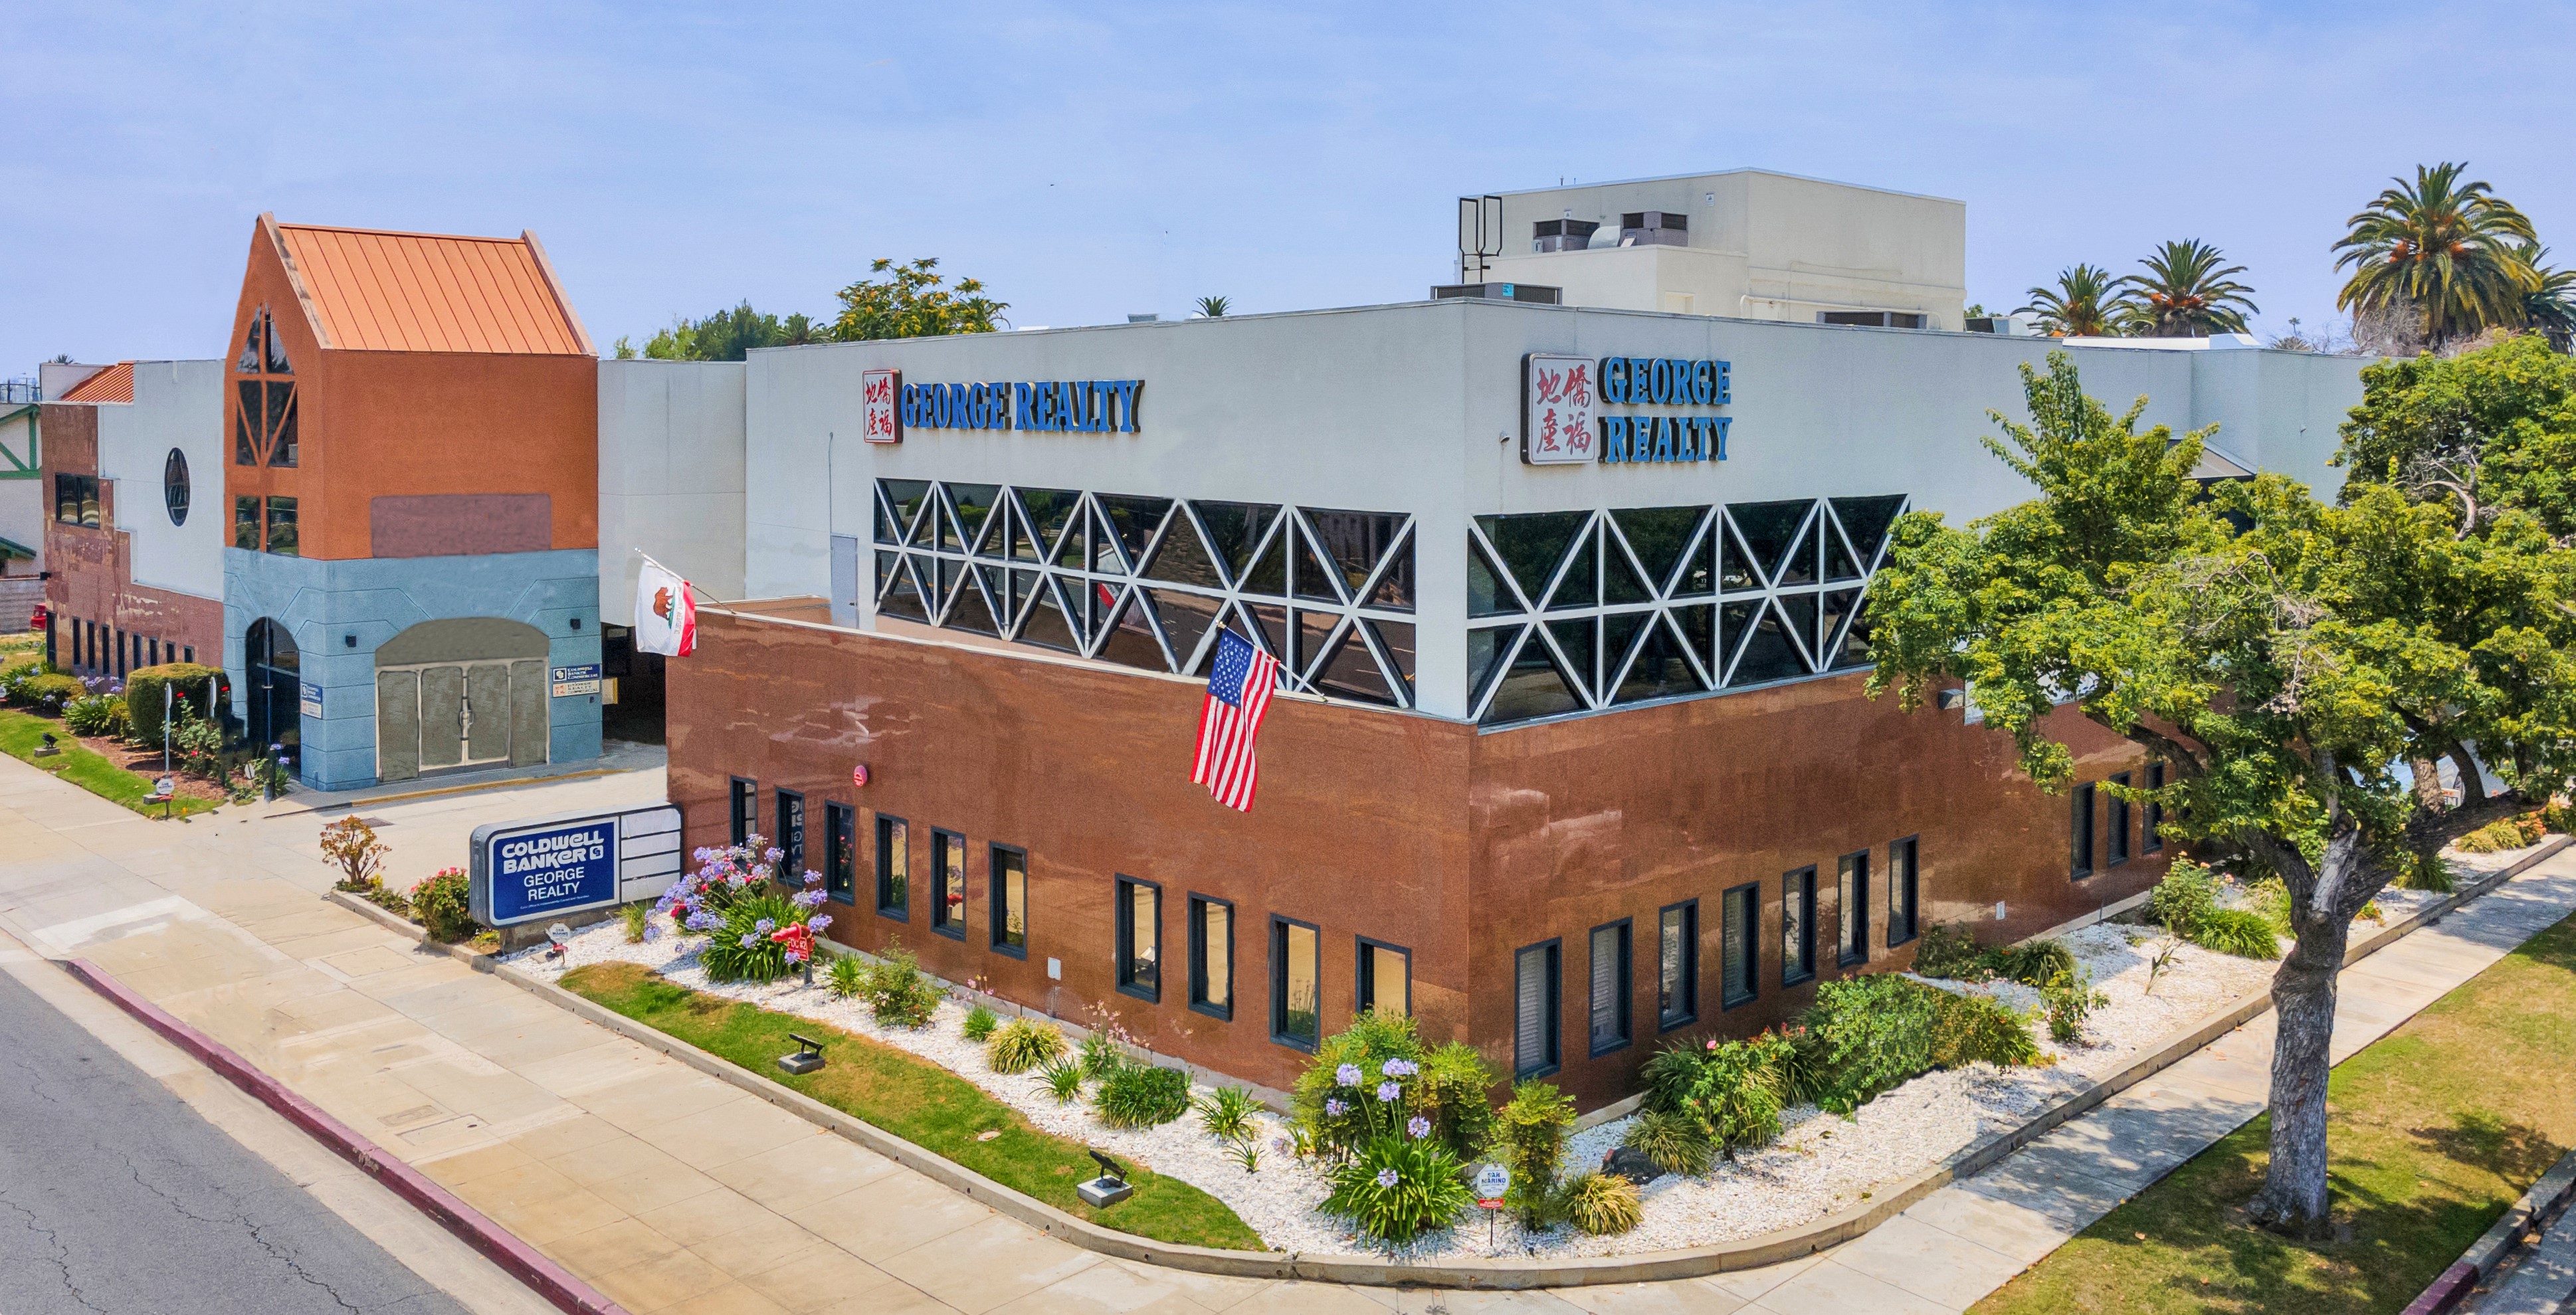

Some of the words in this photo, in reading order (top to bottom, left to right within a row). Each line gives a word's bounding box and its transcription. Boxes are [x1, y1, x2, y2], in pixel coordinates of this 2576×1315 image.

[1602, 355, 1732, 405] GEORGE
[901, 381, 1009, 430] GEORGE
[1014, 380, 1143, 433] REALTY
[1602, 415, 1733, 464] REALTY
[524, 866, 585, 887] GEORGE
[528, 881, 580, 901] REALTY
